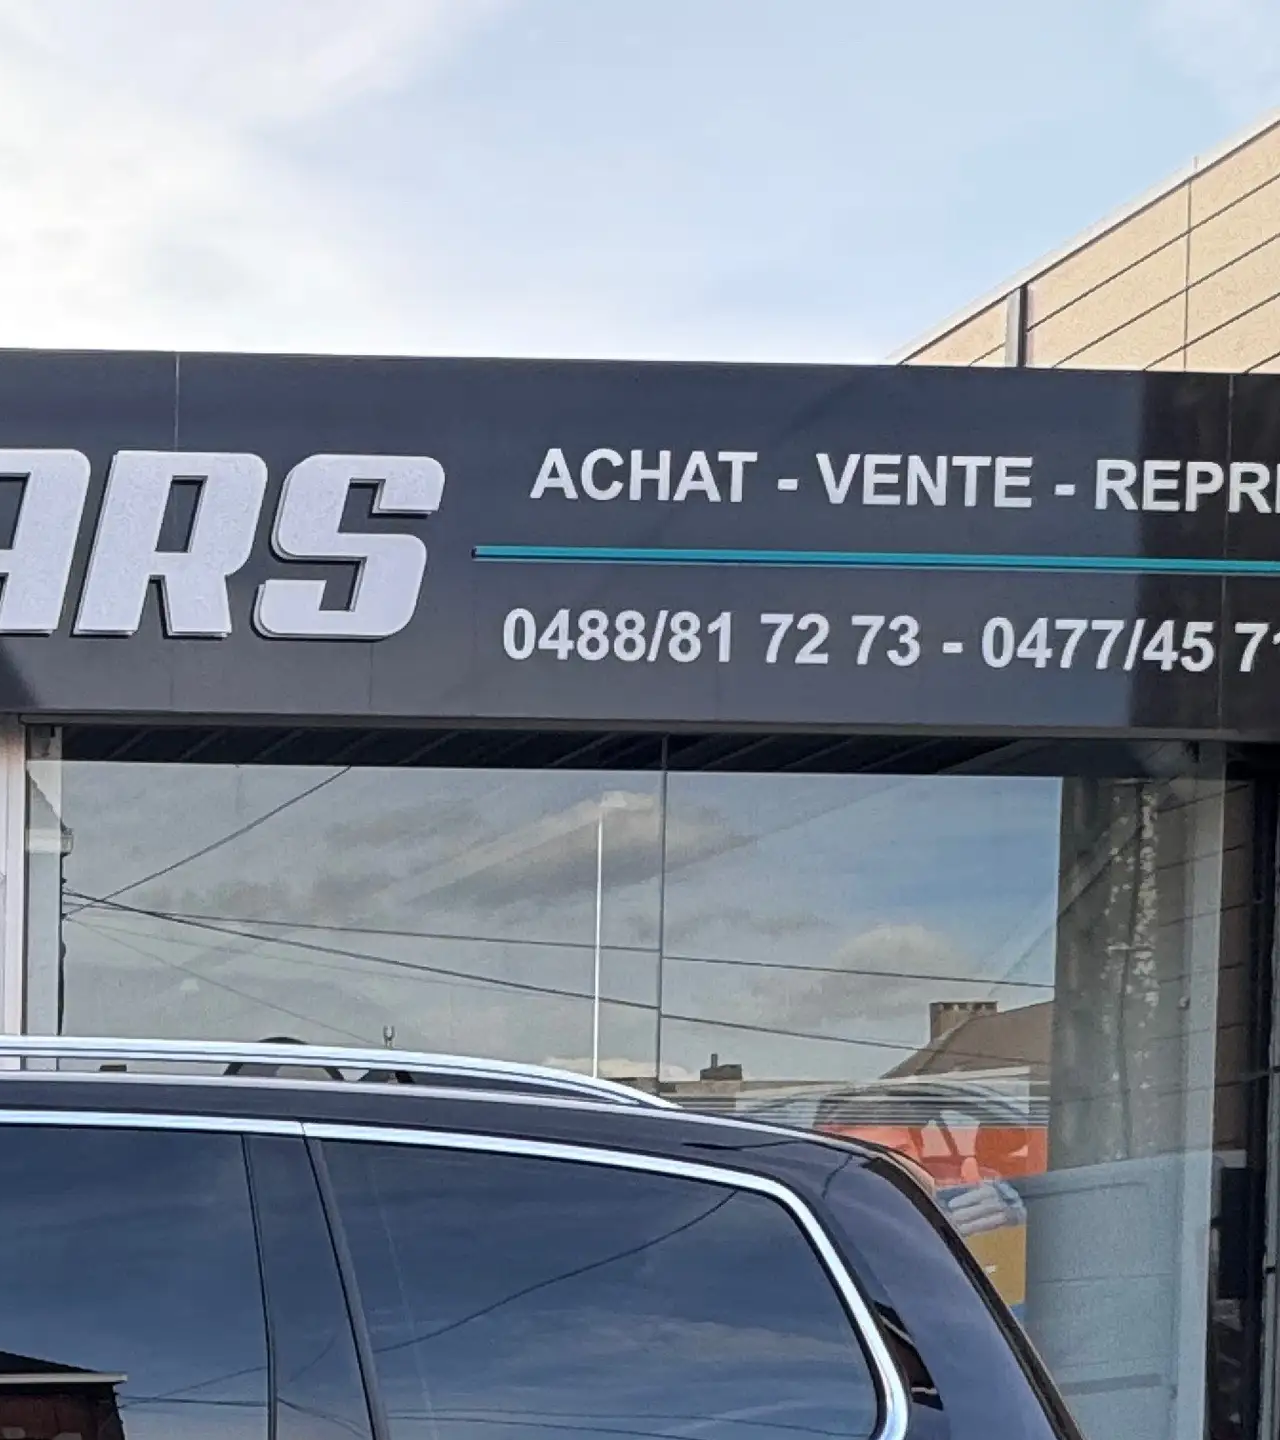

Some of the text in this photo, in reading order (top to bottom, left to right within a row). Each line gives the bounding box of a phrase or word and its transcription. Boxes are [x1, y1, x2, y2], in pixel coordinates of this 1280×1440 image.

[529, 447, 758, 503] ACHAT
[816, 452, 1034, 509] VENTE
[502, 608, 732, 664] 0488/81
[759, 612, 829, 666] 72
[851, 614, 921, 668] 73
[981, 616, 1215, 672] 0477/45
